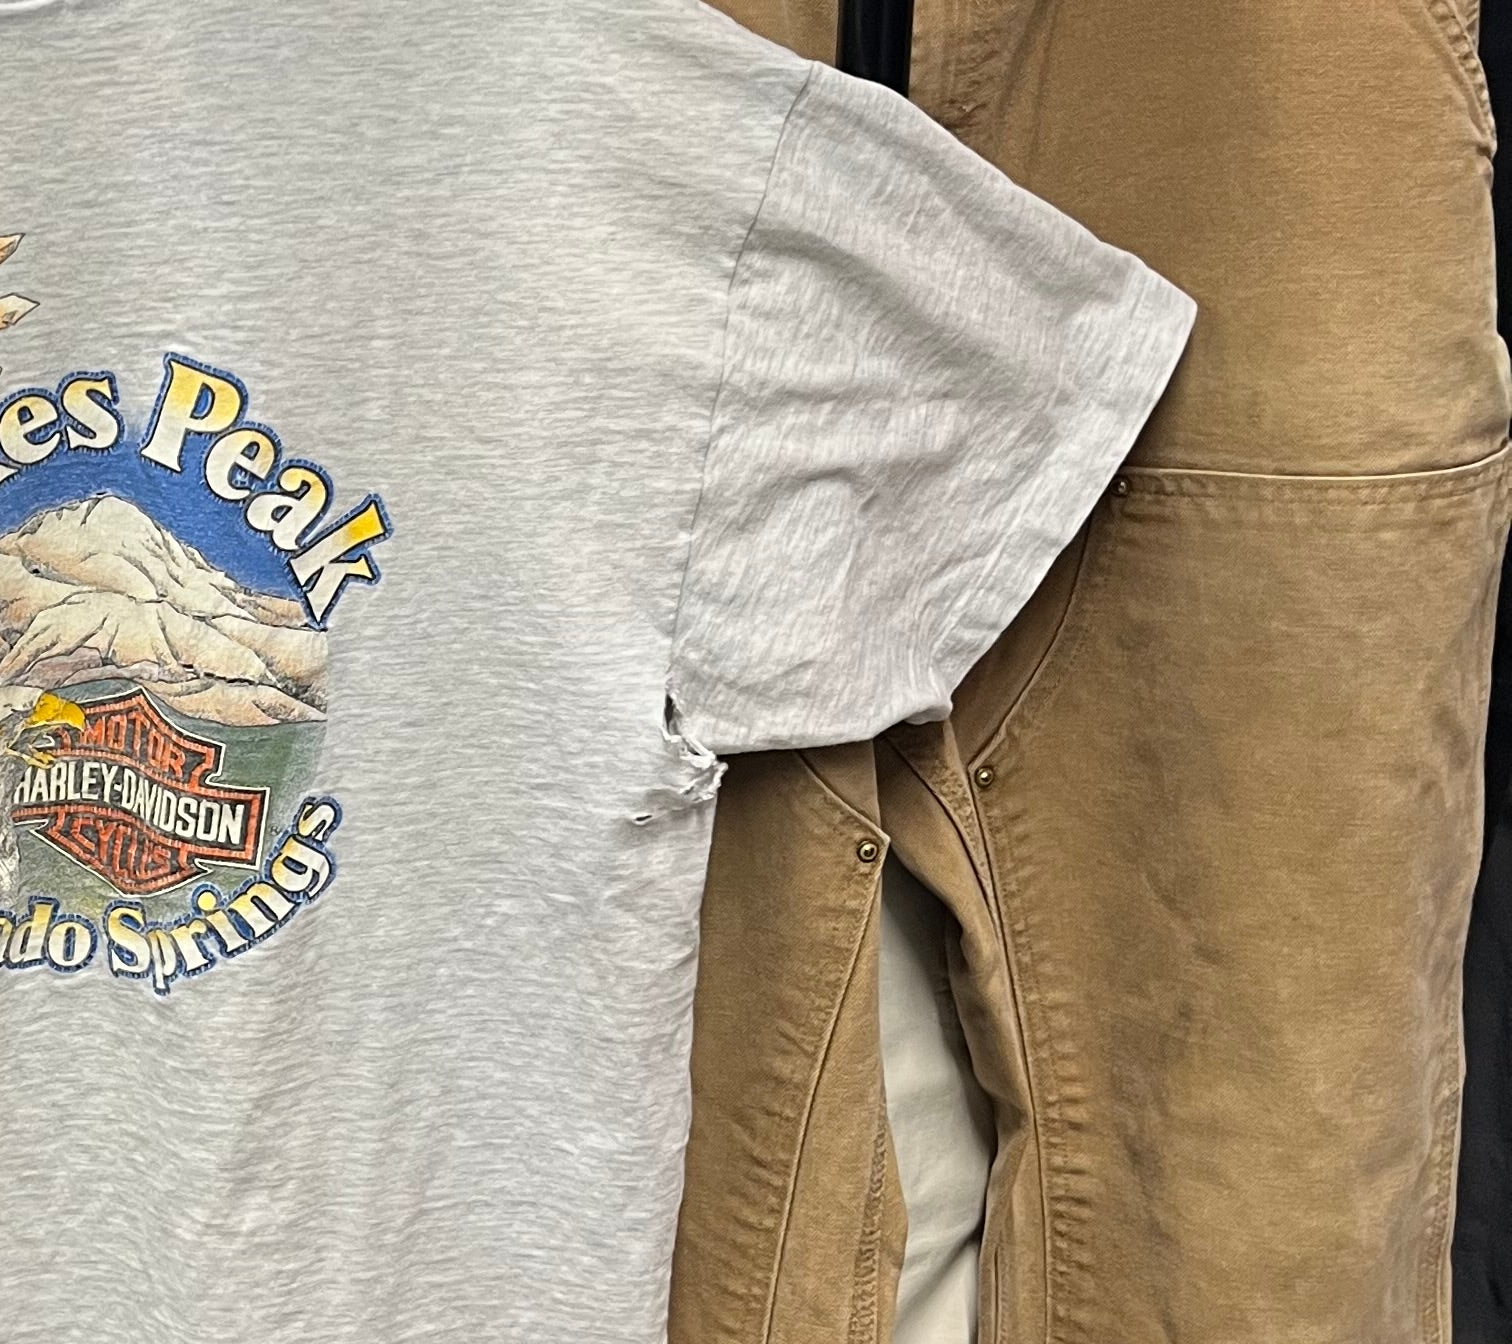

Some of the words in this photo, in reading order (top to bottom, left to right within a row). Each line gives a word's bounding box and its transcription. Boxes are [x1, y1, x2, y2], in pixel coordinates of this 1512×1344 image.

[139, 352, 393, 631] Peak
[14, 759, 245, 845] HARLEY-DAVIDSON
[79, 711, 186, 779] MOTOR
[106, 798, 341, 995] Springs
